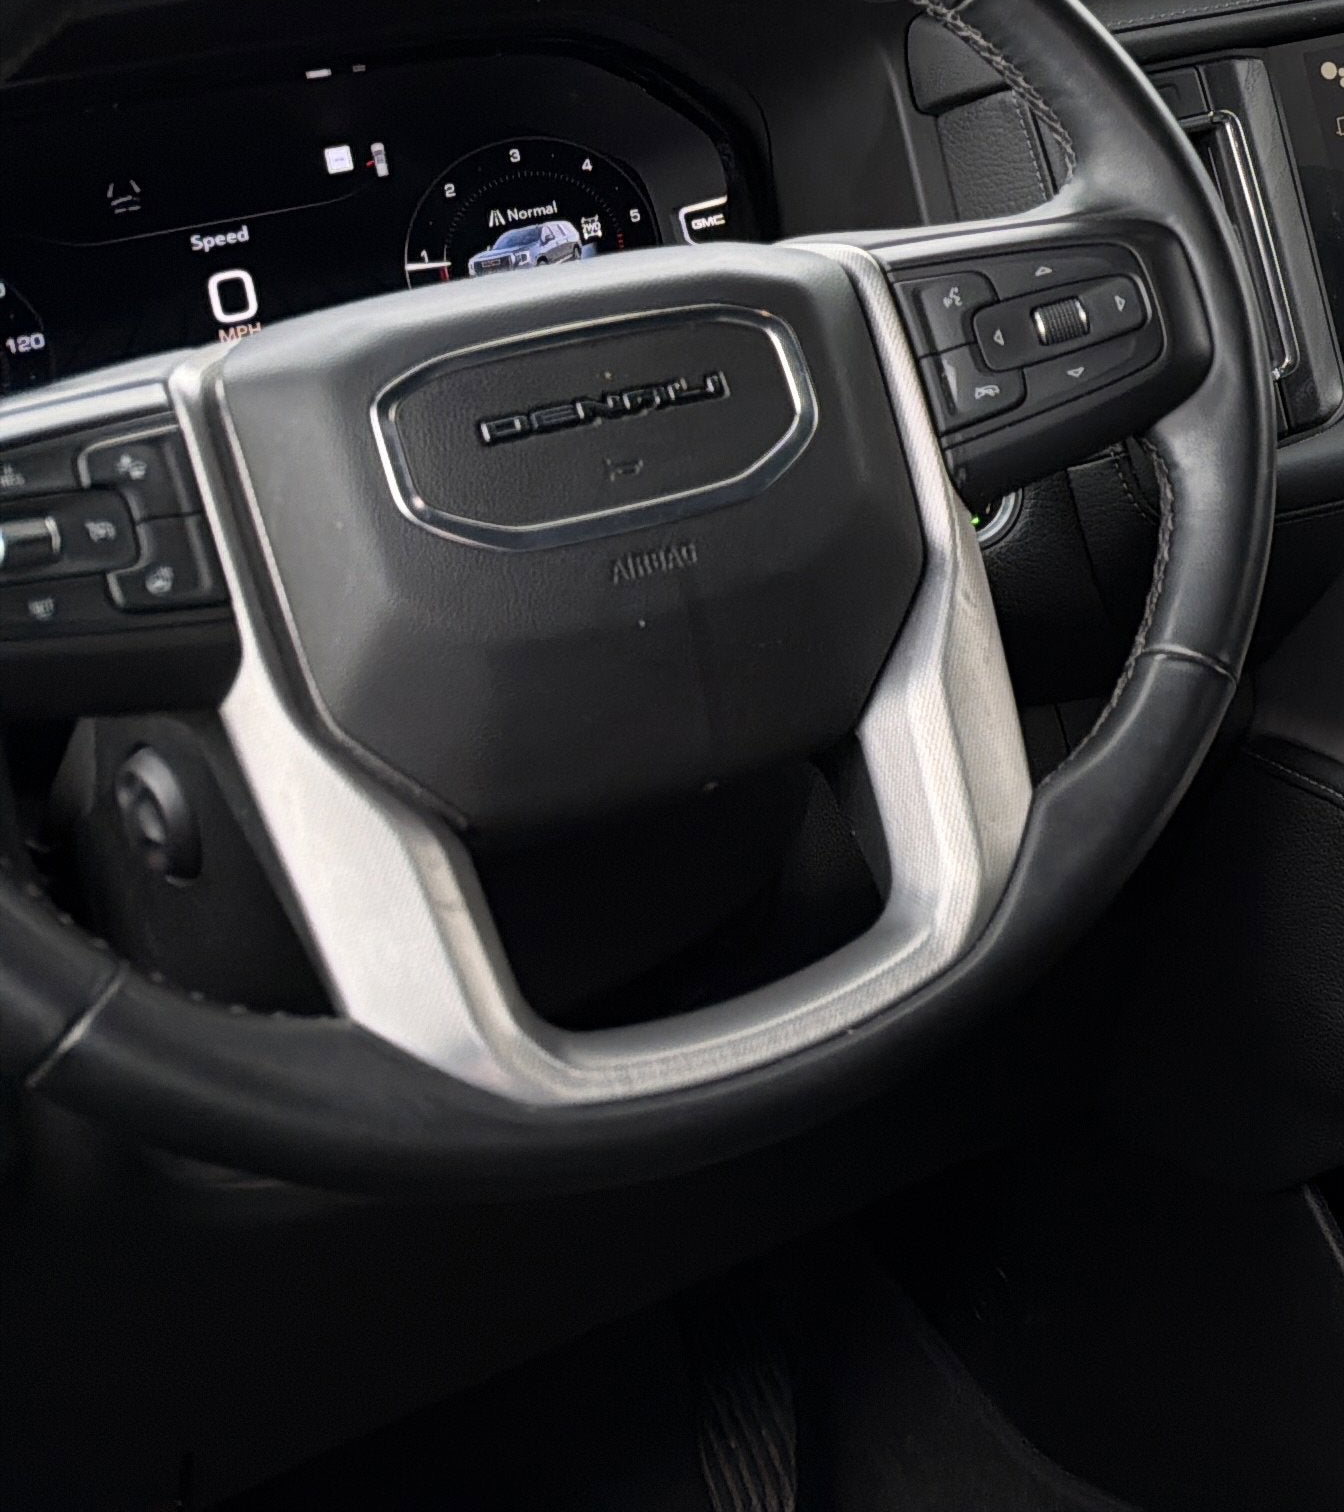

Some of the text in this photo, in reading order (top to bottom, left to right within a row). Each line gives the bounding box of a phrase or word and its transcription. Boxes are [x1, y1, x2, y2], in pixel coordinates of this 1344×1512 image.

[509, 148, 521, 163] 3
[581, 158, 593, 172] 4
[444, 183, 457, 198] 2
[507, 200, 559, 222] Normal
[629, 208, 641, 223] 5
[691, 213, 726, 230] GMC
[190, 225, 249, 253] Speed
[420, 249, 429, 264] 1
[208, 268, 259, 324] 0
[218, 321, 262, 344] MPH
[5, 333, 46, 355] 120
[478, 368, 732, 446] DENALI
[611, 541, 699, 585] AIRBAG
